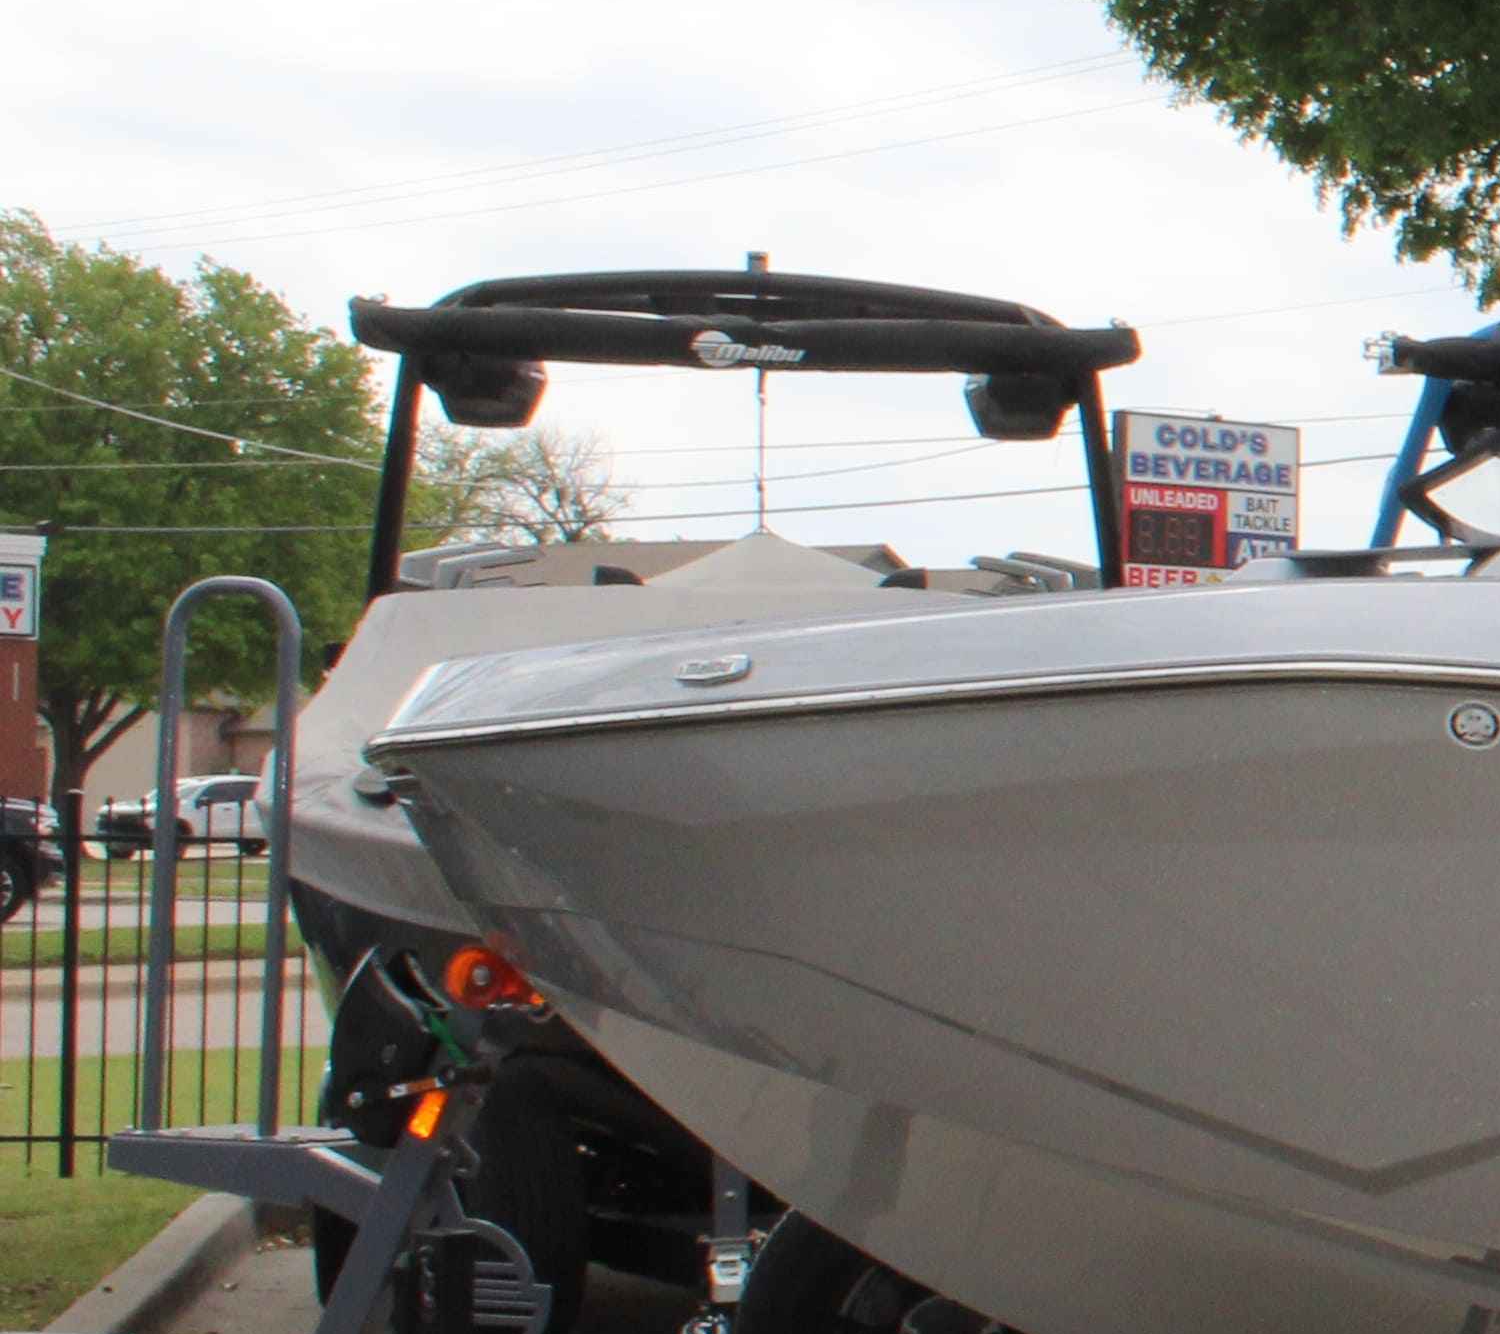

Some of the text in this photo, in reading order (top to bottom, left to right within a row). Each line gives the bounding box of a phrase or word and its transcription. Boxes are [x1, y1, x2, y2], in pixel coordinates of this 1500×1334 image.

[1130, 452, 1292, 488] BEVERAGE
[1130, 488, 1219, 510] UNLEADED
[1246, 497, 1279, 513] BAIT
[1232, 514, 1291, 533] TACKLE
